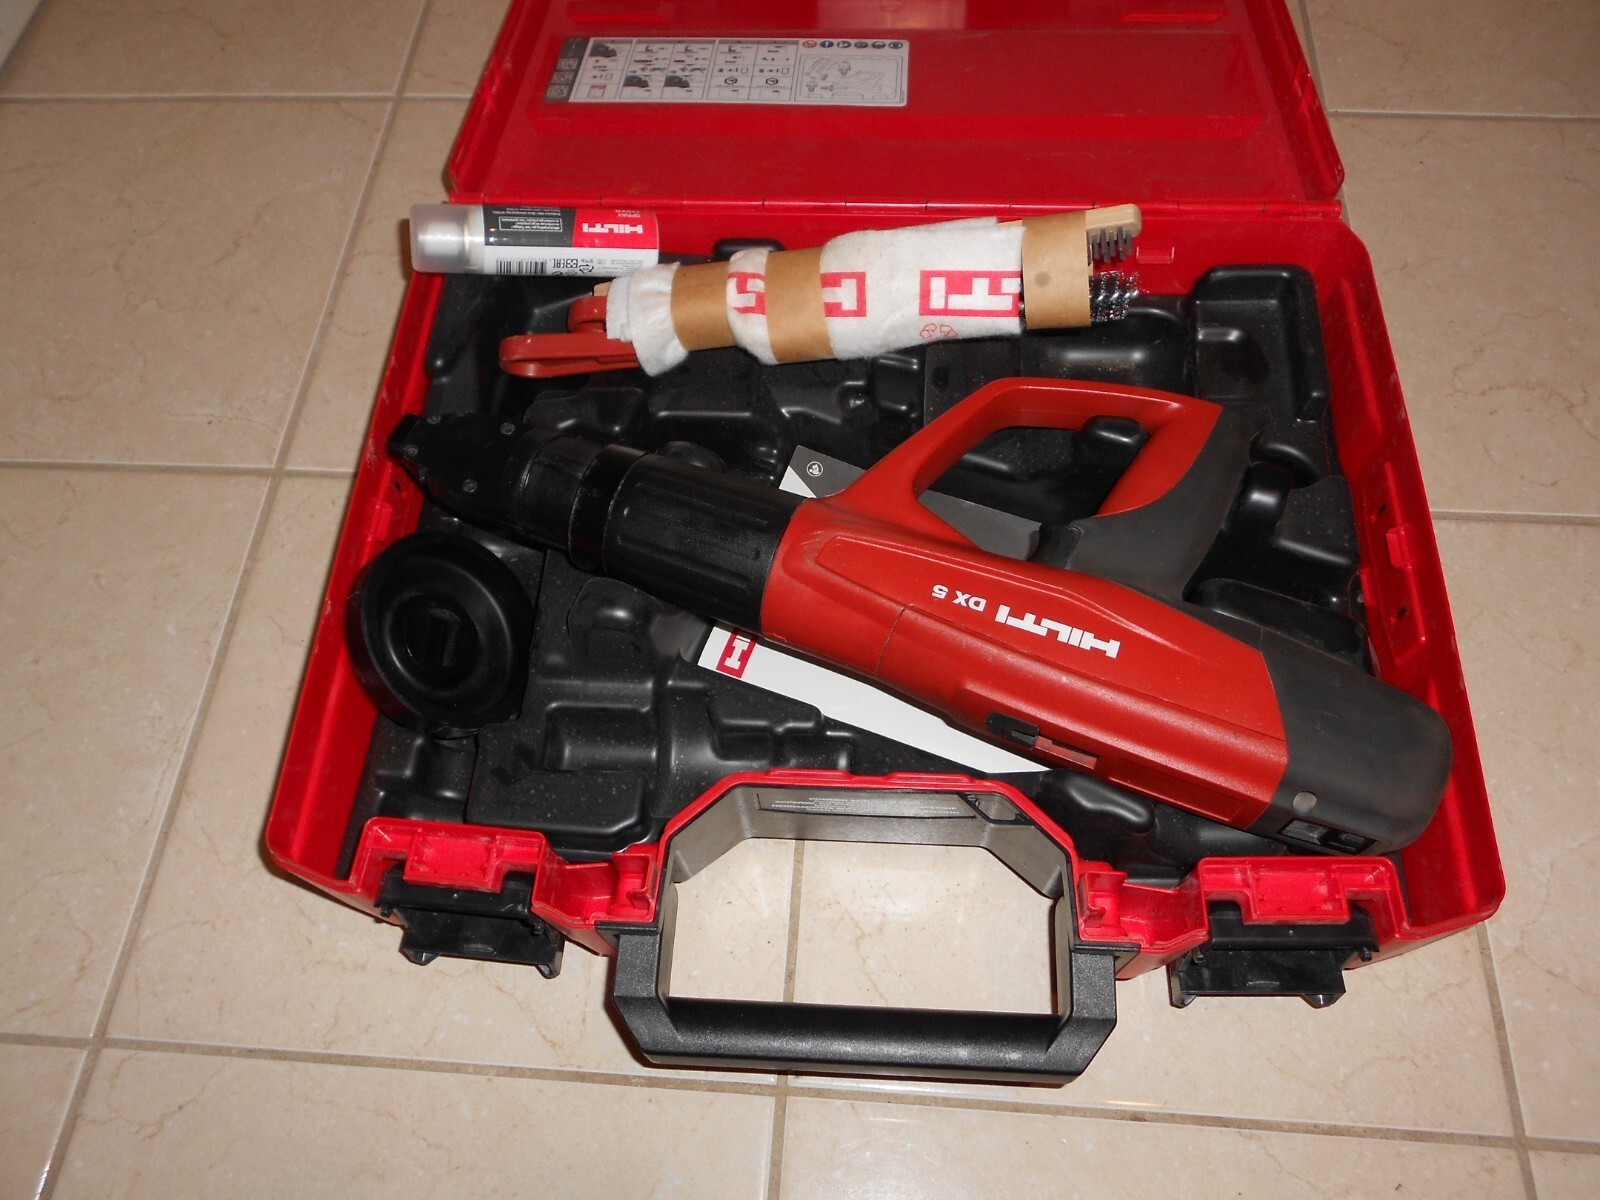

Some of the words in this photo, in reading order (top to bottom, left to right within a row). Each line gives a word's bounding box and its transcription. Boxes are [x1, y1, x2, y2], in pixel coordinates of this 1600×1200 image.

[582, 223, 643, 234] HILTI
[931, 584, 949, 599] 5
[952, 590, 987, 612] DX
[995, 604, 1121, 659] HILTI
